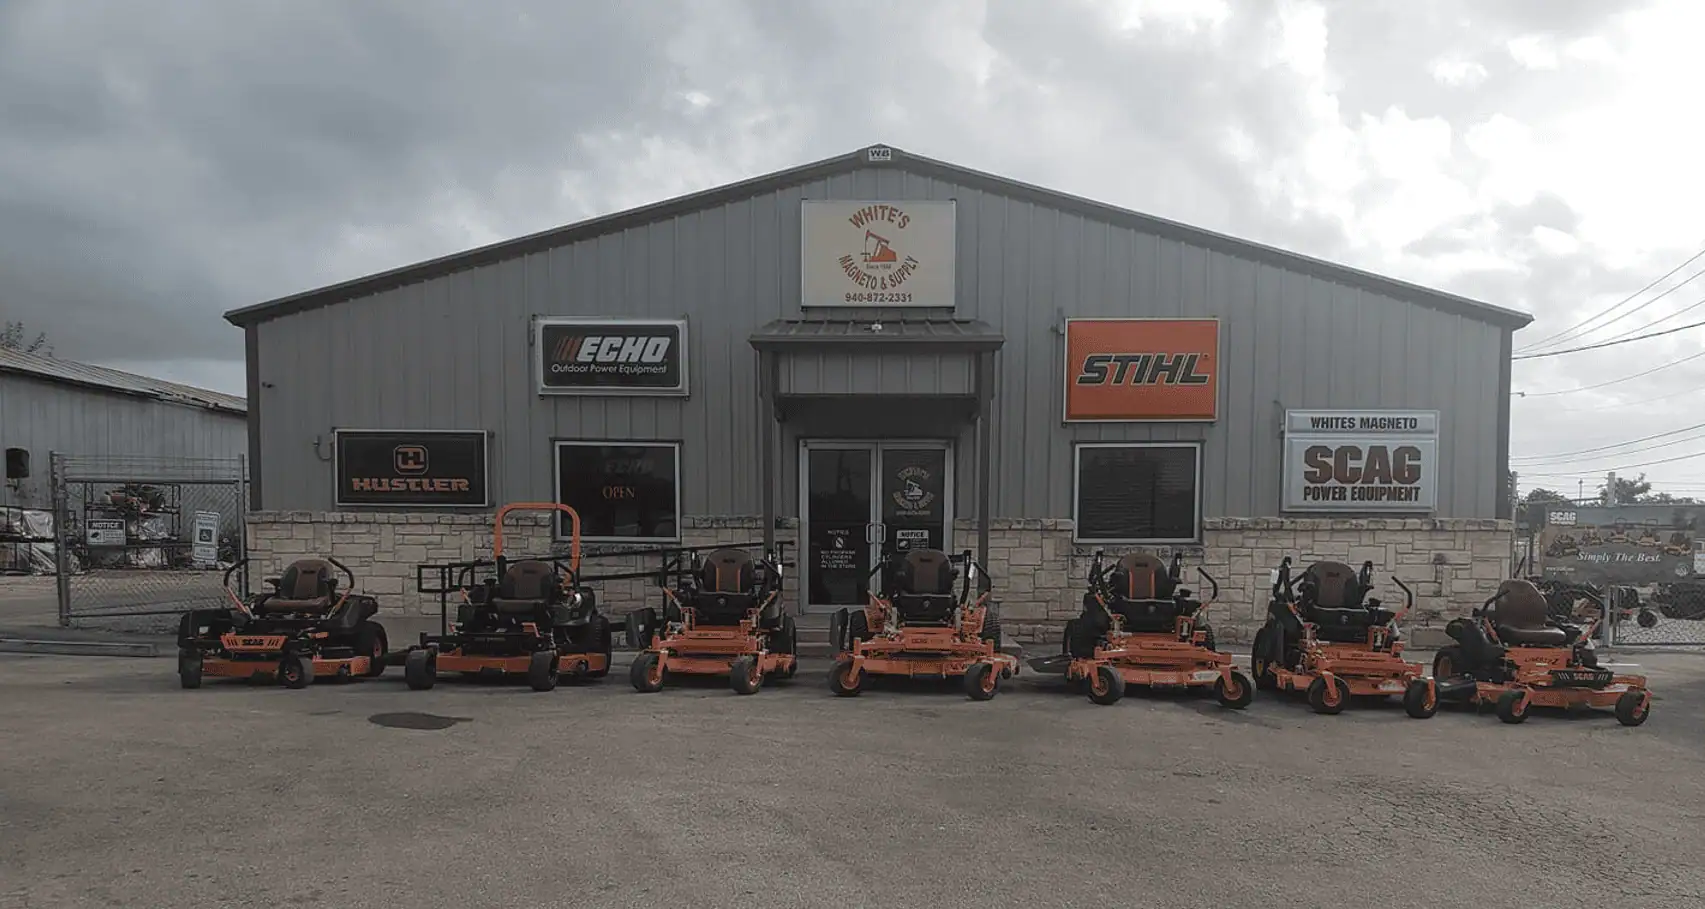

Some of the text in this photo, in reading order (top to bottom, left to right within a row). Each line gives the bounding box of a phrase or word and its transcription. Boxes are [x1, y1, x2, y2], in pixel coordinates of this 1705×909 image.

[849, 205, 911, 229] WHITE'S
[839, 255, 919, 290] MAGNETO & SUPPLY
[845, 292, 912, 302] 940-872-2331
[576, 336, 671, 362] ECHO
[551, 363, 667, 375] Outdoor Power Equipment
[1076, 353, 1210, 386] STIHL
[1311, 416, 1418, 429] WHITES MAGNETO
[1304, 445, 1421, 485] SCAG
[352, 478, 470, 491] HUSTLER
[602, 486, 635, 499] OPEN
[1304, 486, 1421, 501] POWER EQUIPMENT
[1550, 511, 1576, 521] SCAG
[1577, 552, 1661, 564] Simply The Best.
